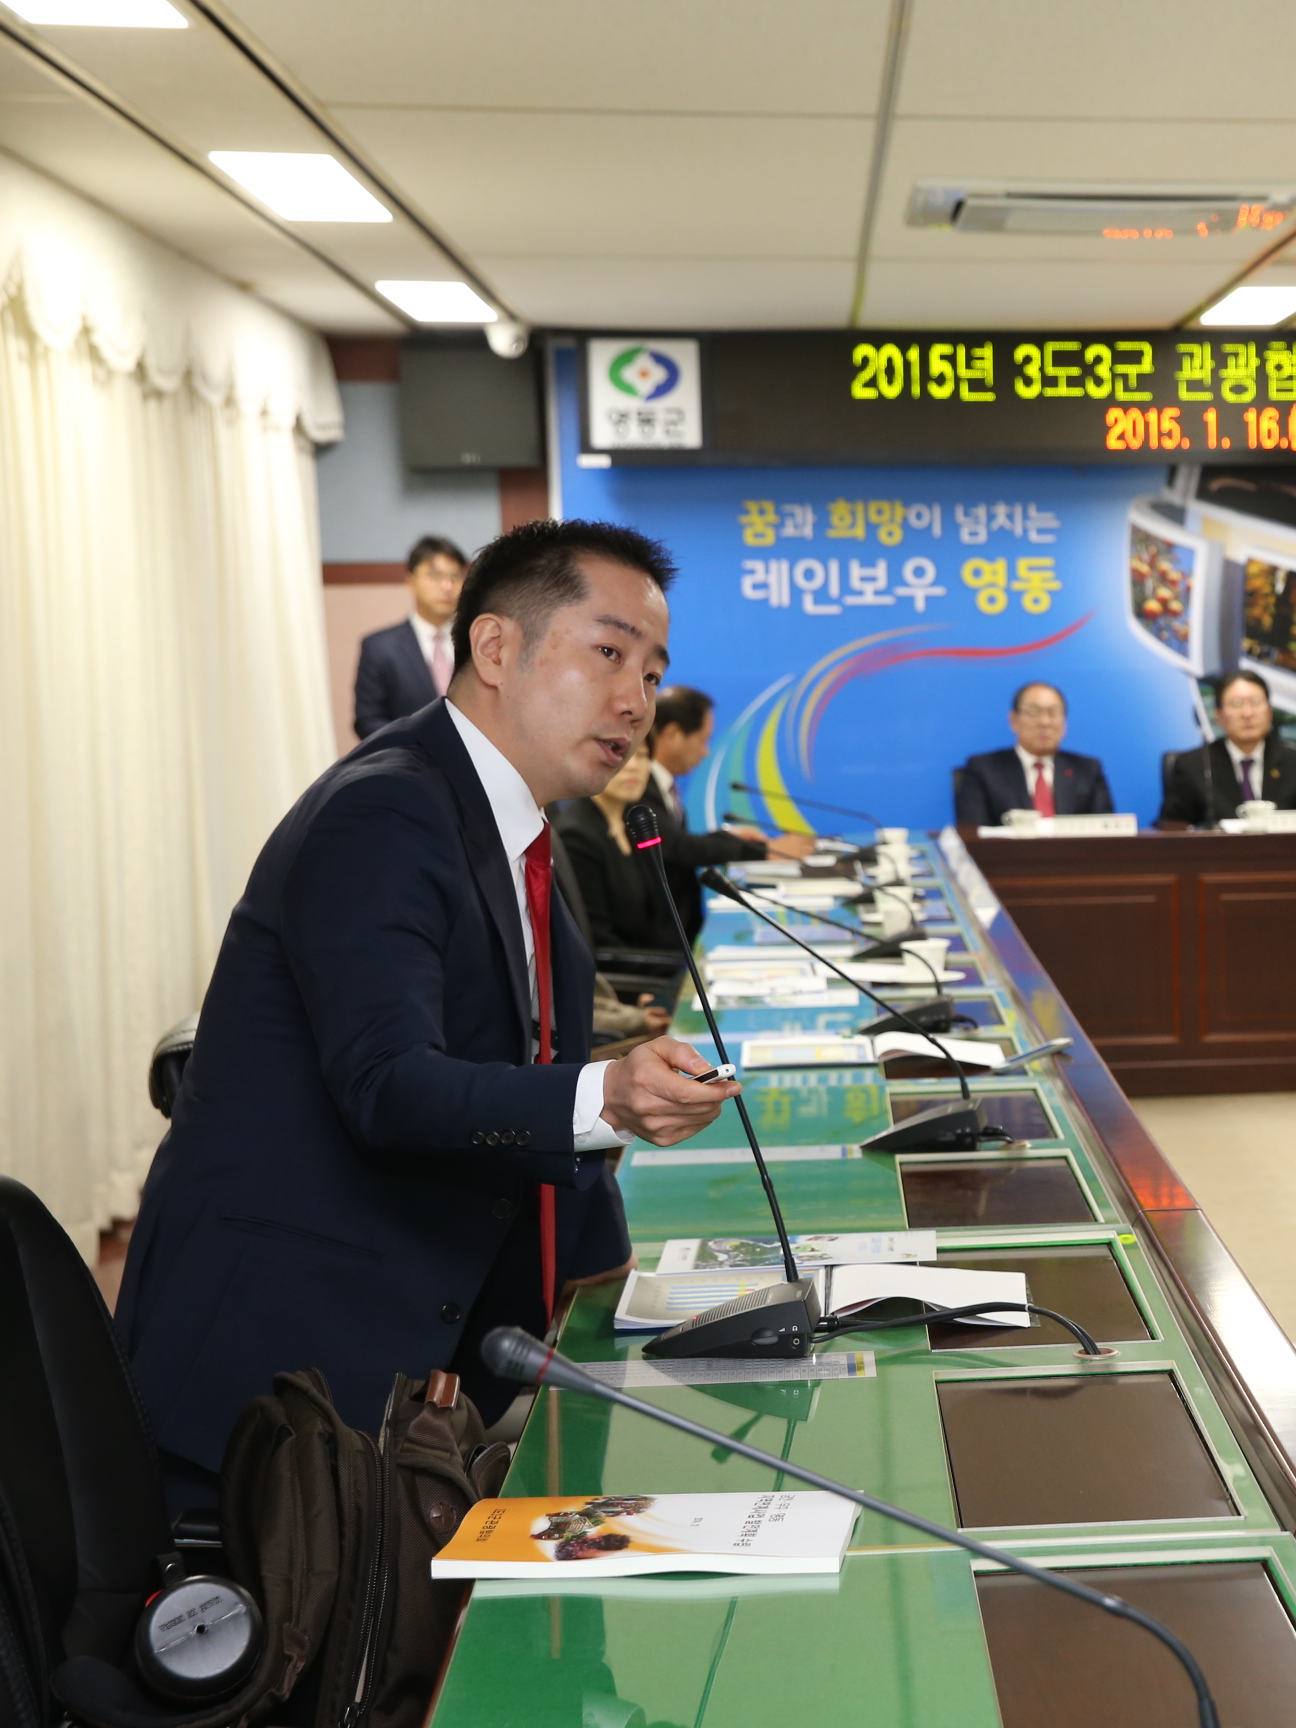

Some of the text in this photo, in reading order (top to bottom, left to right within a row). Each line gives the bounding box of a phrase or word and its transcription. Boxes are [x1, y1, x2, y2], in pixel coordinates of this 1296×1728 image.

[852, 342, 996, 402] 2015년
[1014, 341, 1154, 402] 3도3군
[1105, 407, 1191, 450] 2015.
[1203, 408, 1232, 449] 1.
[738, 498, 1062, 547] 꿈과 희망이 넘치는
[740, 556, 1064, 615] 레인보우 영동
